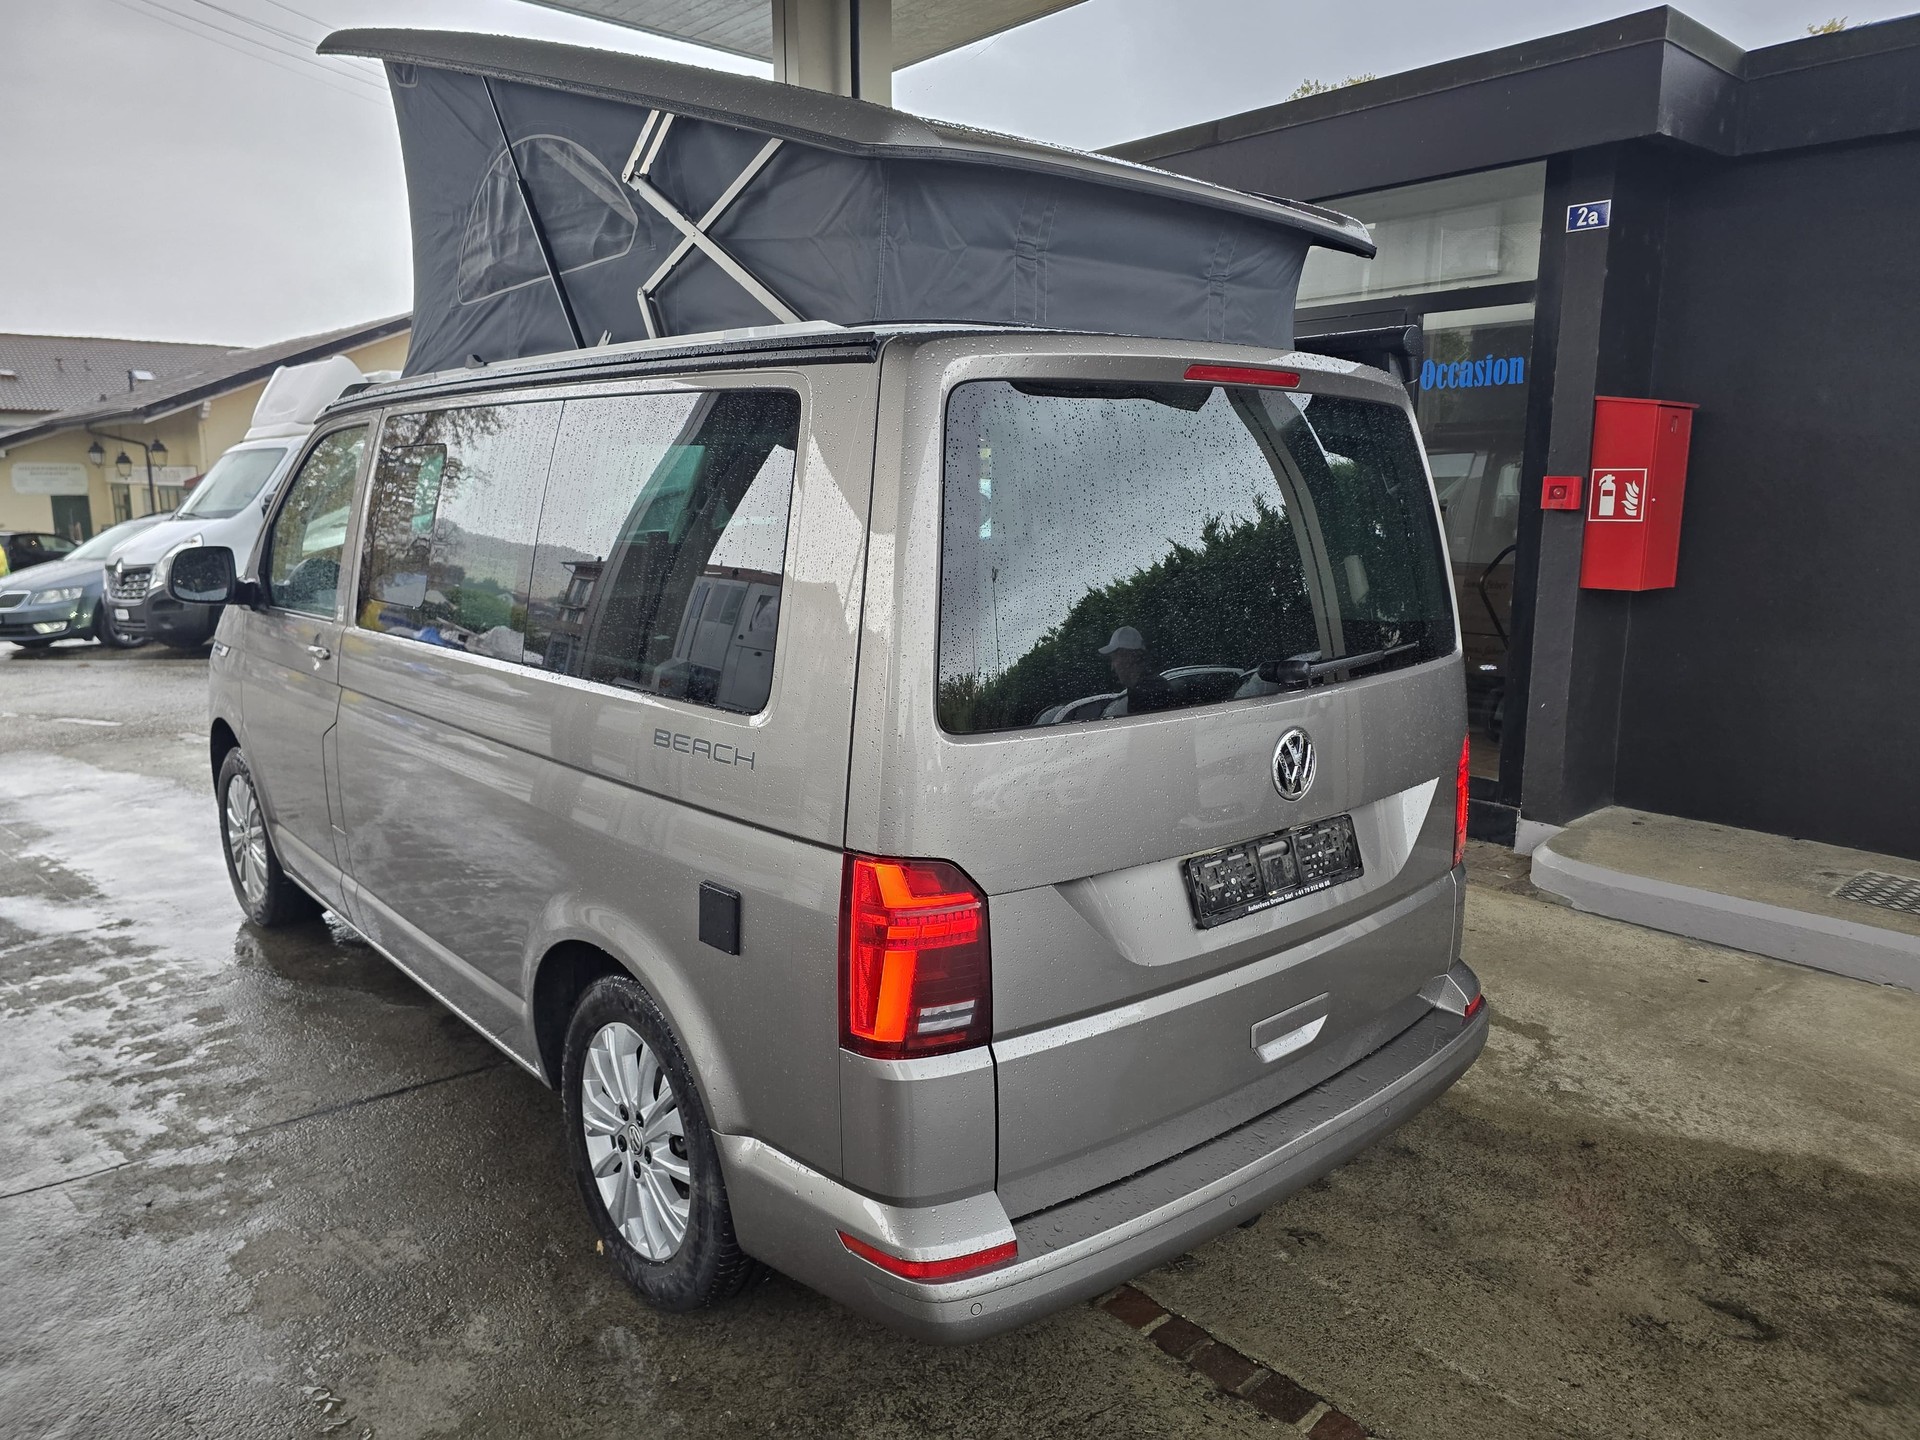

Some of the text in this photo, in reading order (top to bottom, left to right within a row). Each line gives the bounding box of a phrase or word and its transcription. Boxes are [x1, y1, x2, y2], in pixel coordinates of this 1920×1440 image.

[1577, 207, 1598, 227] 2a
[1420, 354, 1525, 391] Occasion
[653, 728, 755, 770] BEACH
[1295, 889, 1304, 897] +41
[1310, 884, 1319, 892] 212
